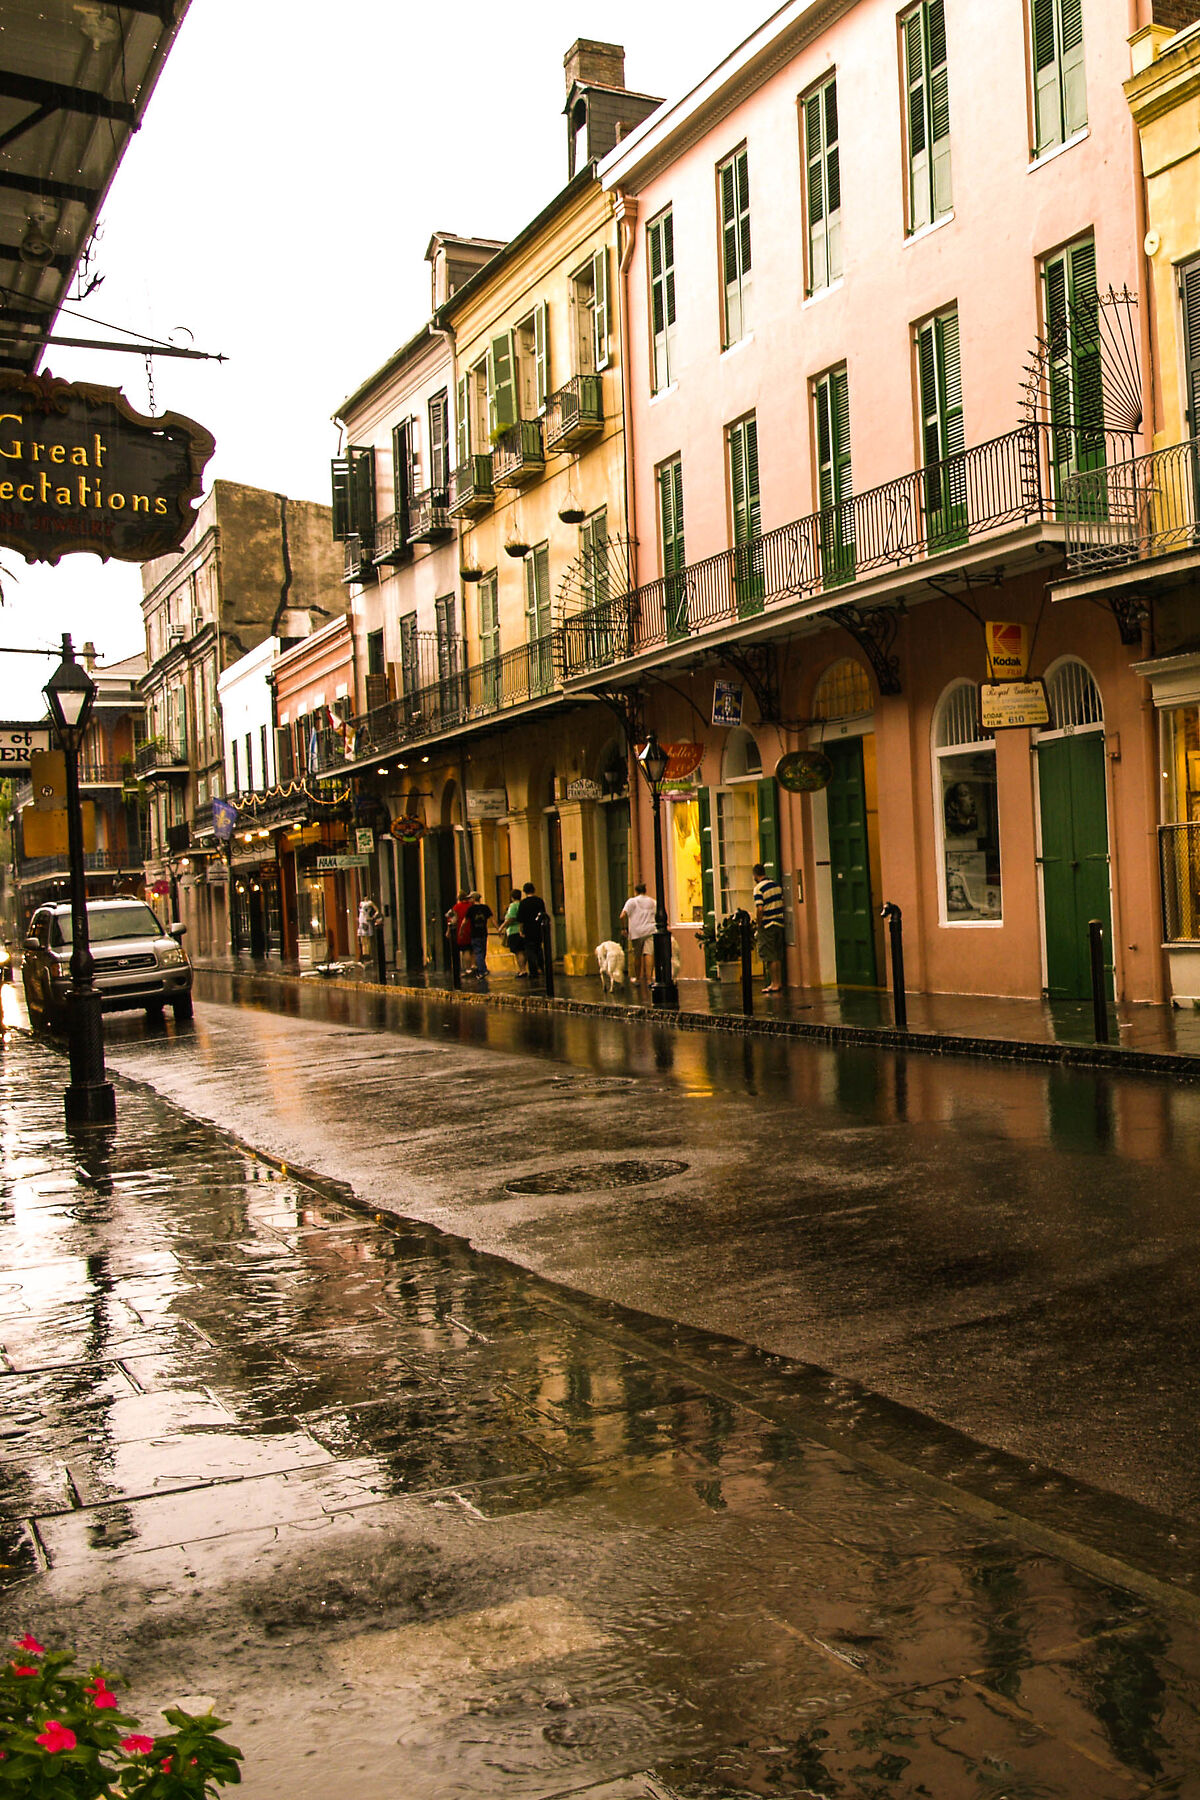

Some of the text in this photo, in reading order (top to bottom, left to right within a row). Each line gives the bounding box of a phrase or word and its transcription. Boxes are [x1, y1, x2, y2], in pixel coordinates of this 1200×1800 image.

[993, 656, 1021, 666] Kodak
[11, 731, 32, 747] of
[0, 747, 44, 762] ER
